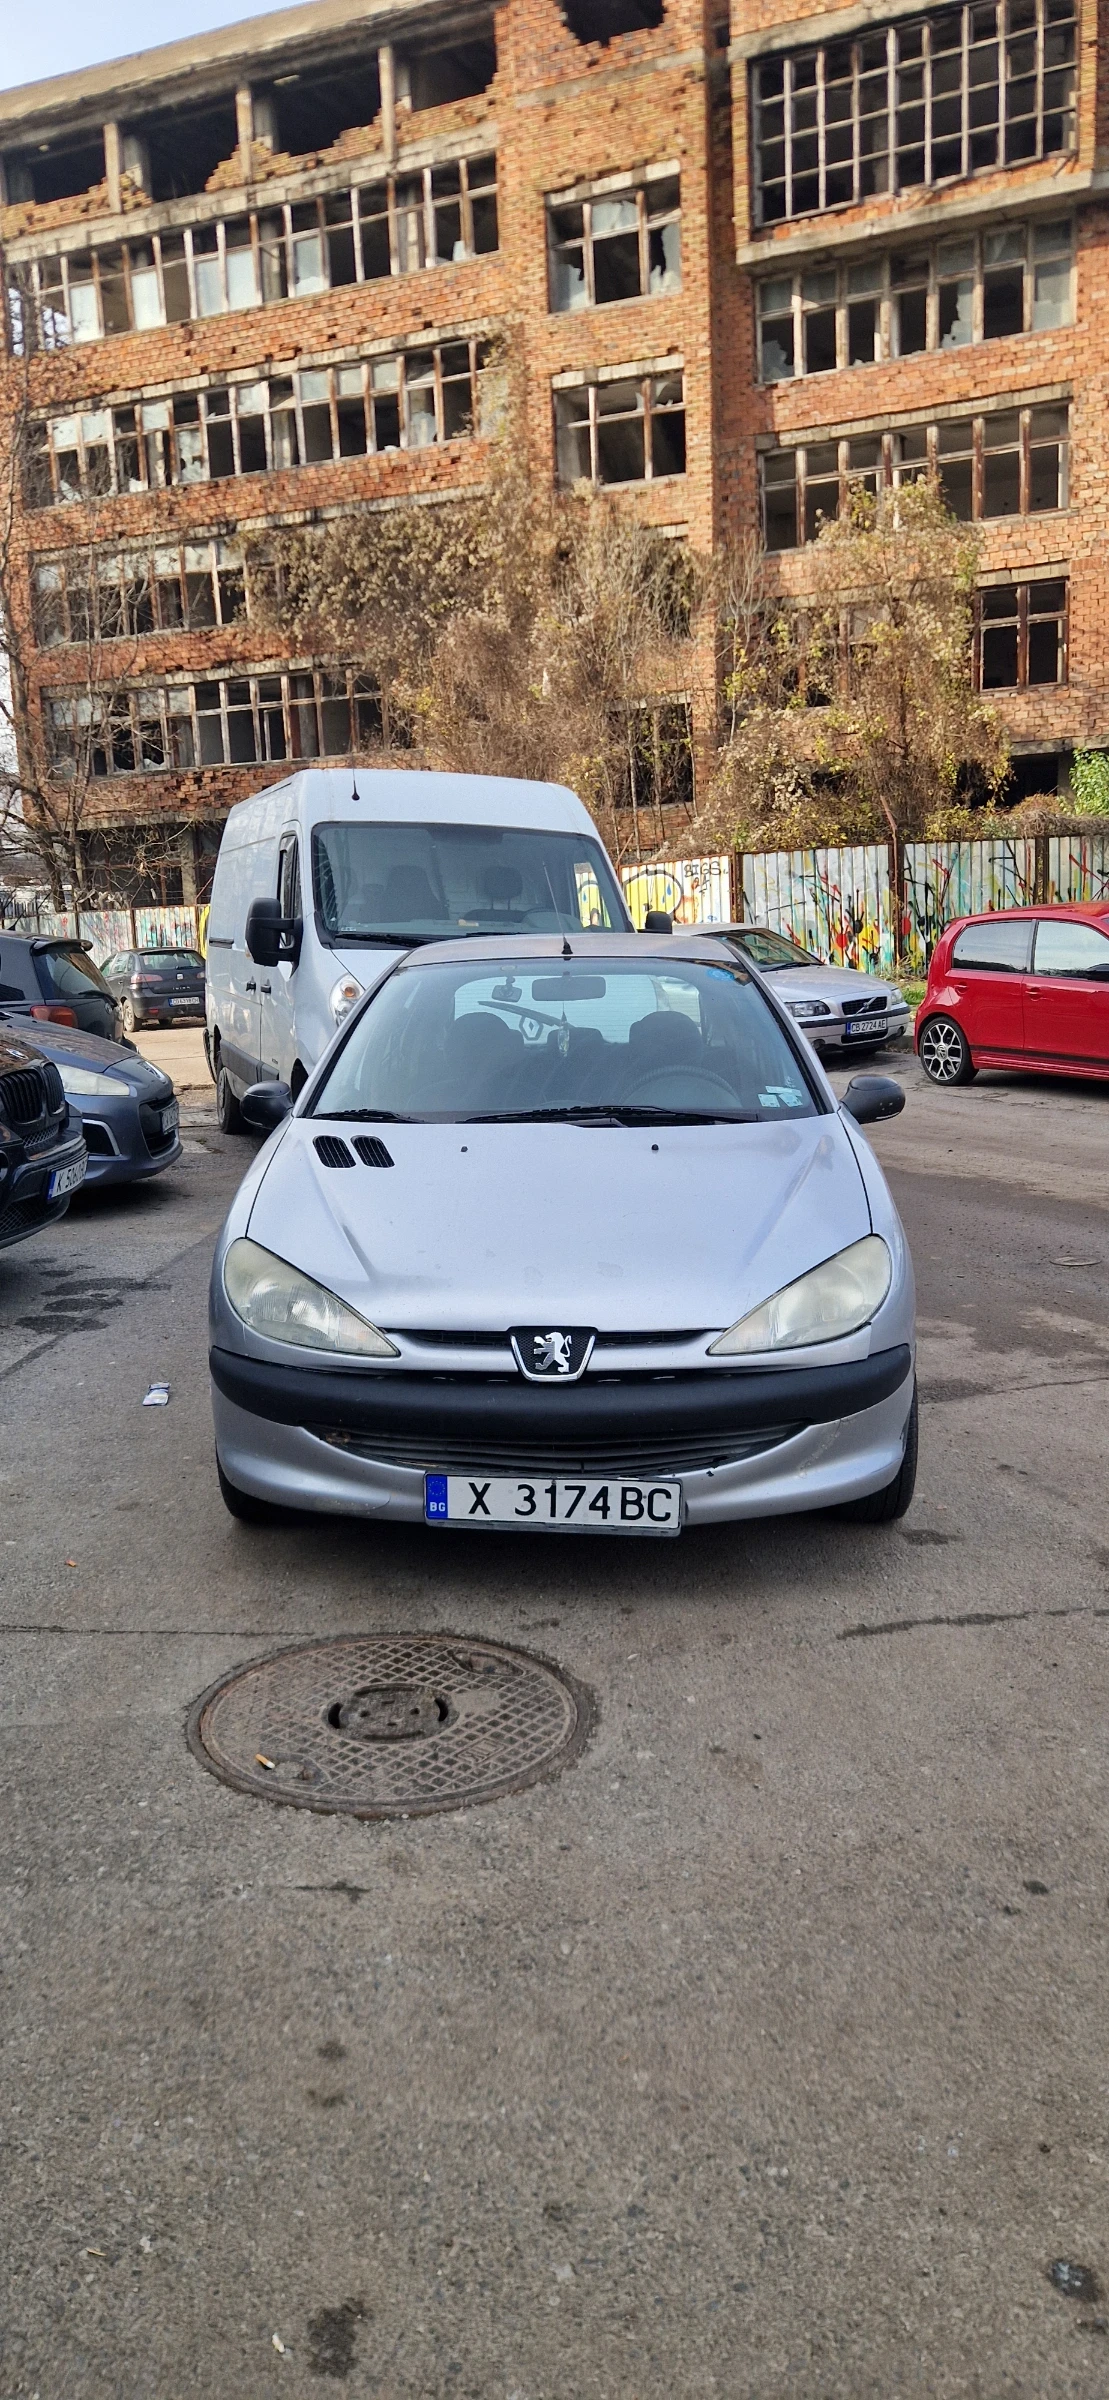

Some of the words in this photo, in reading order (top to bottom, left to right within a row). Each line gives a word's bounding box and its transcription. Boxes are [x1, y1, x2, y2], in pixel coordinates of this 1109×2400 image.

[861, 1020, 877, 1031] 2724
[878, 1019, 886, 1029] AE
[468, 1482, 491, 1515] X
[429, 1501, 446, 1512] BG
